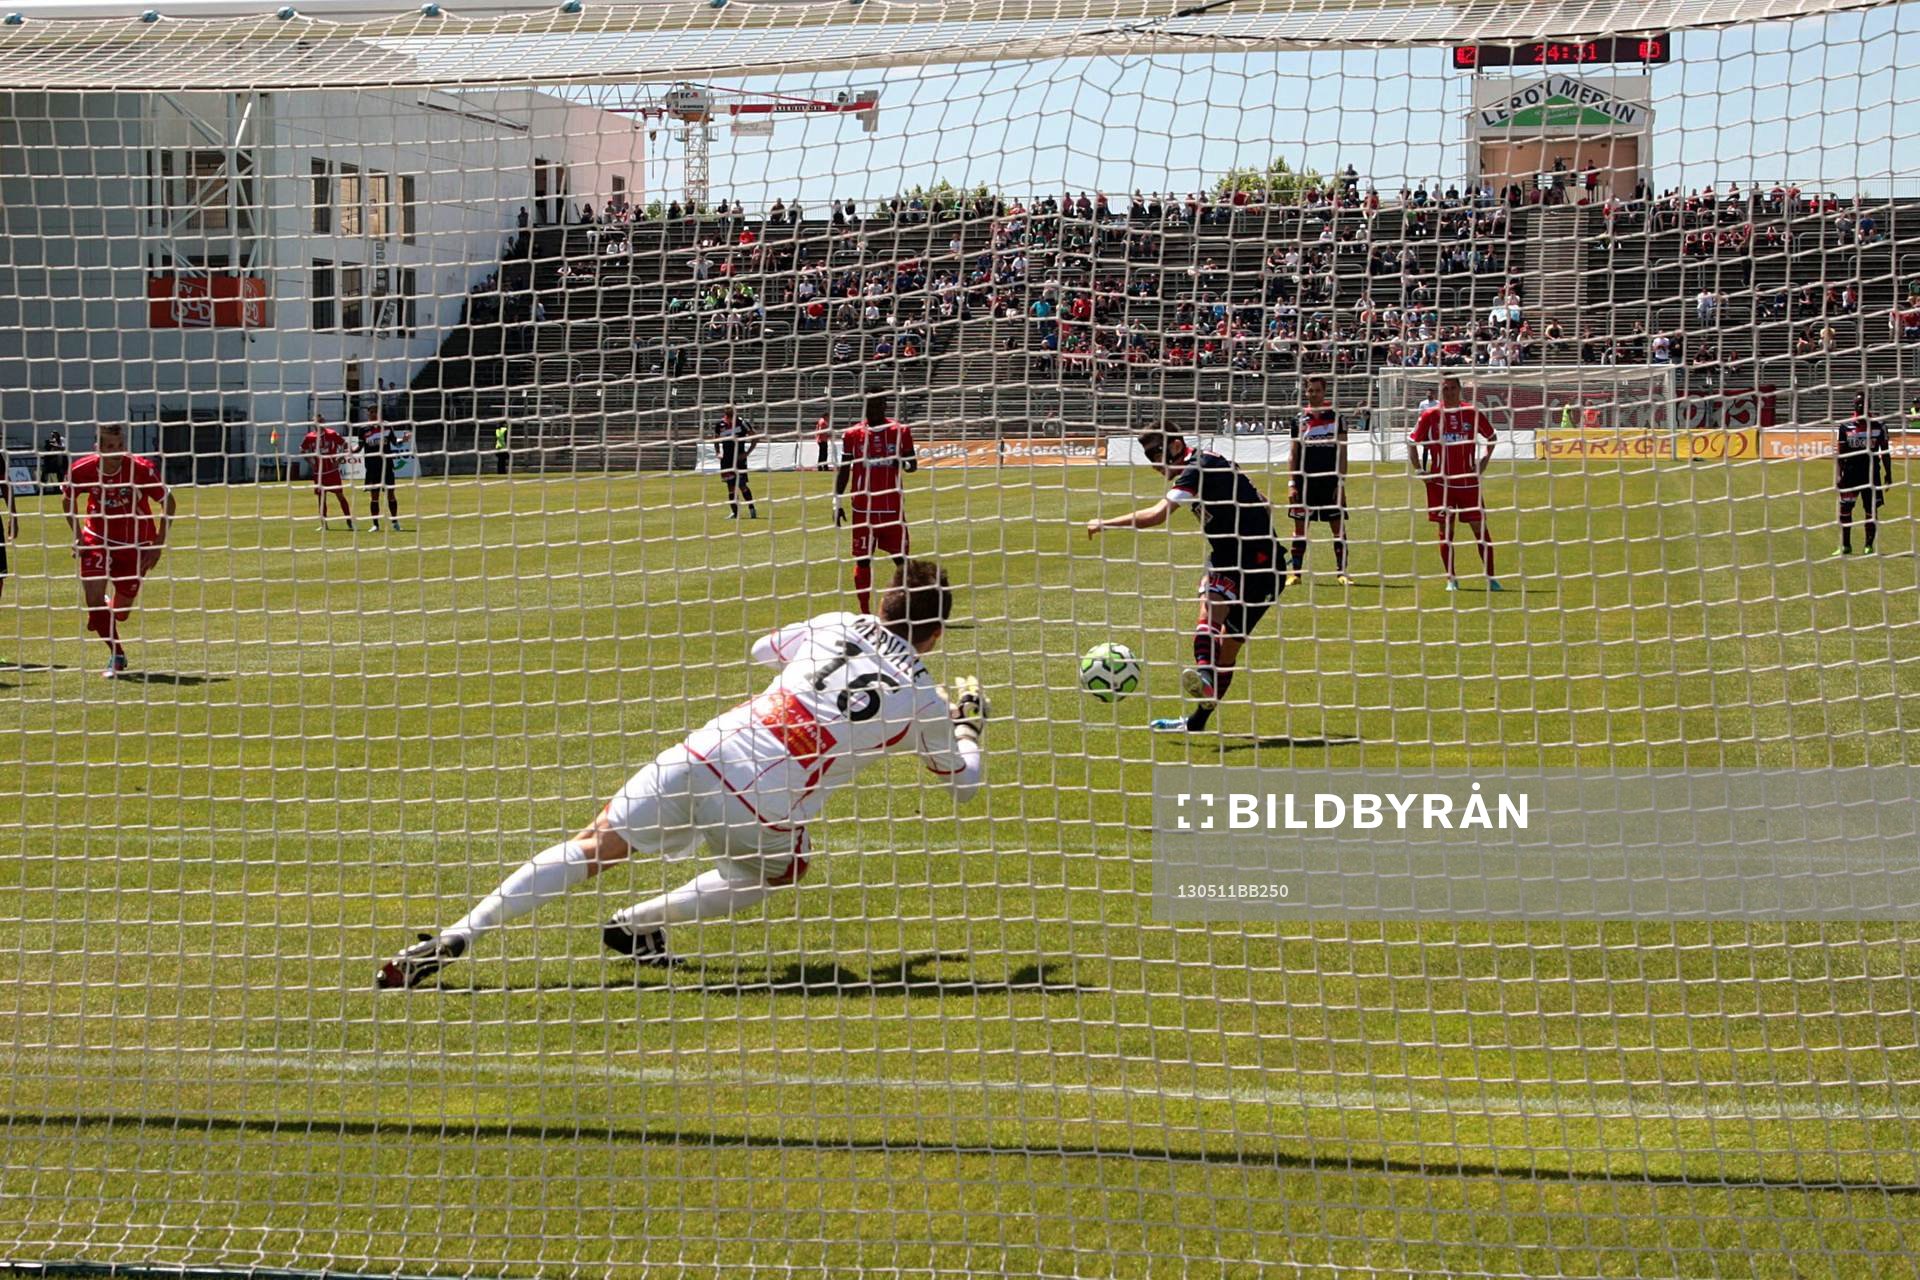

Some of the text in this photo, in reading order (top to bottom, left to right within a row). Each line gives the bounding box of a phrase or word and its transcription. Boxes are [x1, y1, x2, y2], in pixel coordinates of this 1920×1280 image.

[1481, 79, 1636, 127] LEROY MERLIN
[1546, 437, 1674, 456] GARAGE
[805, 638, 900, 722] 16
